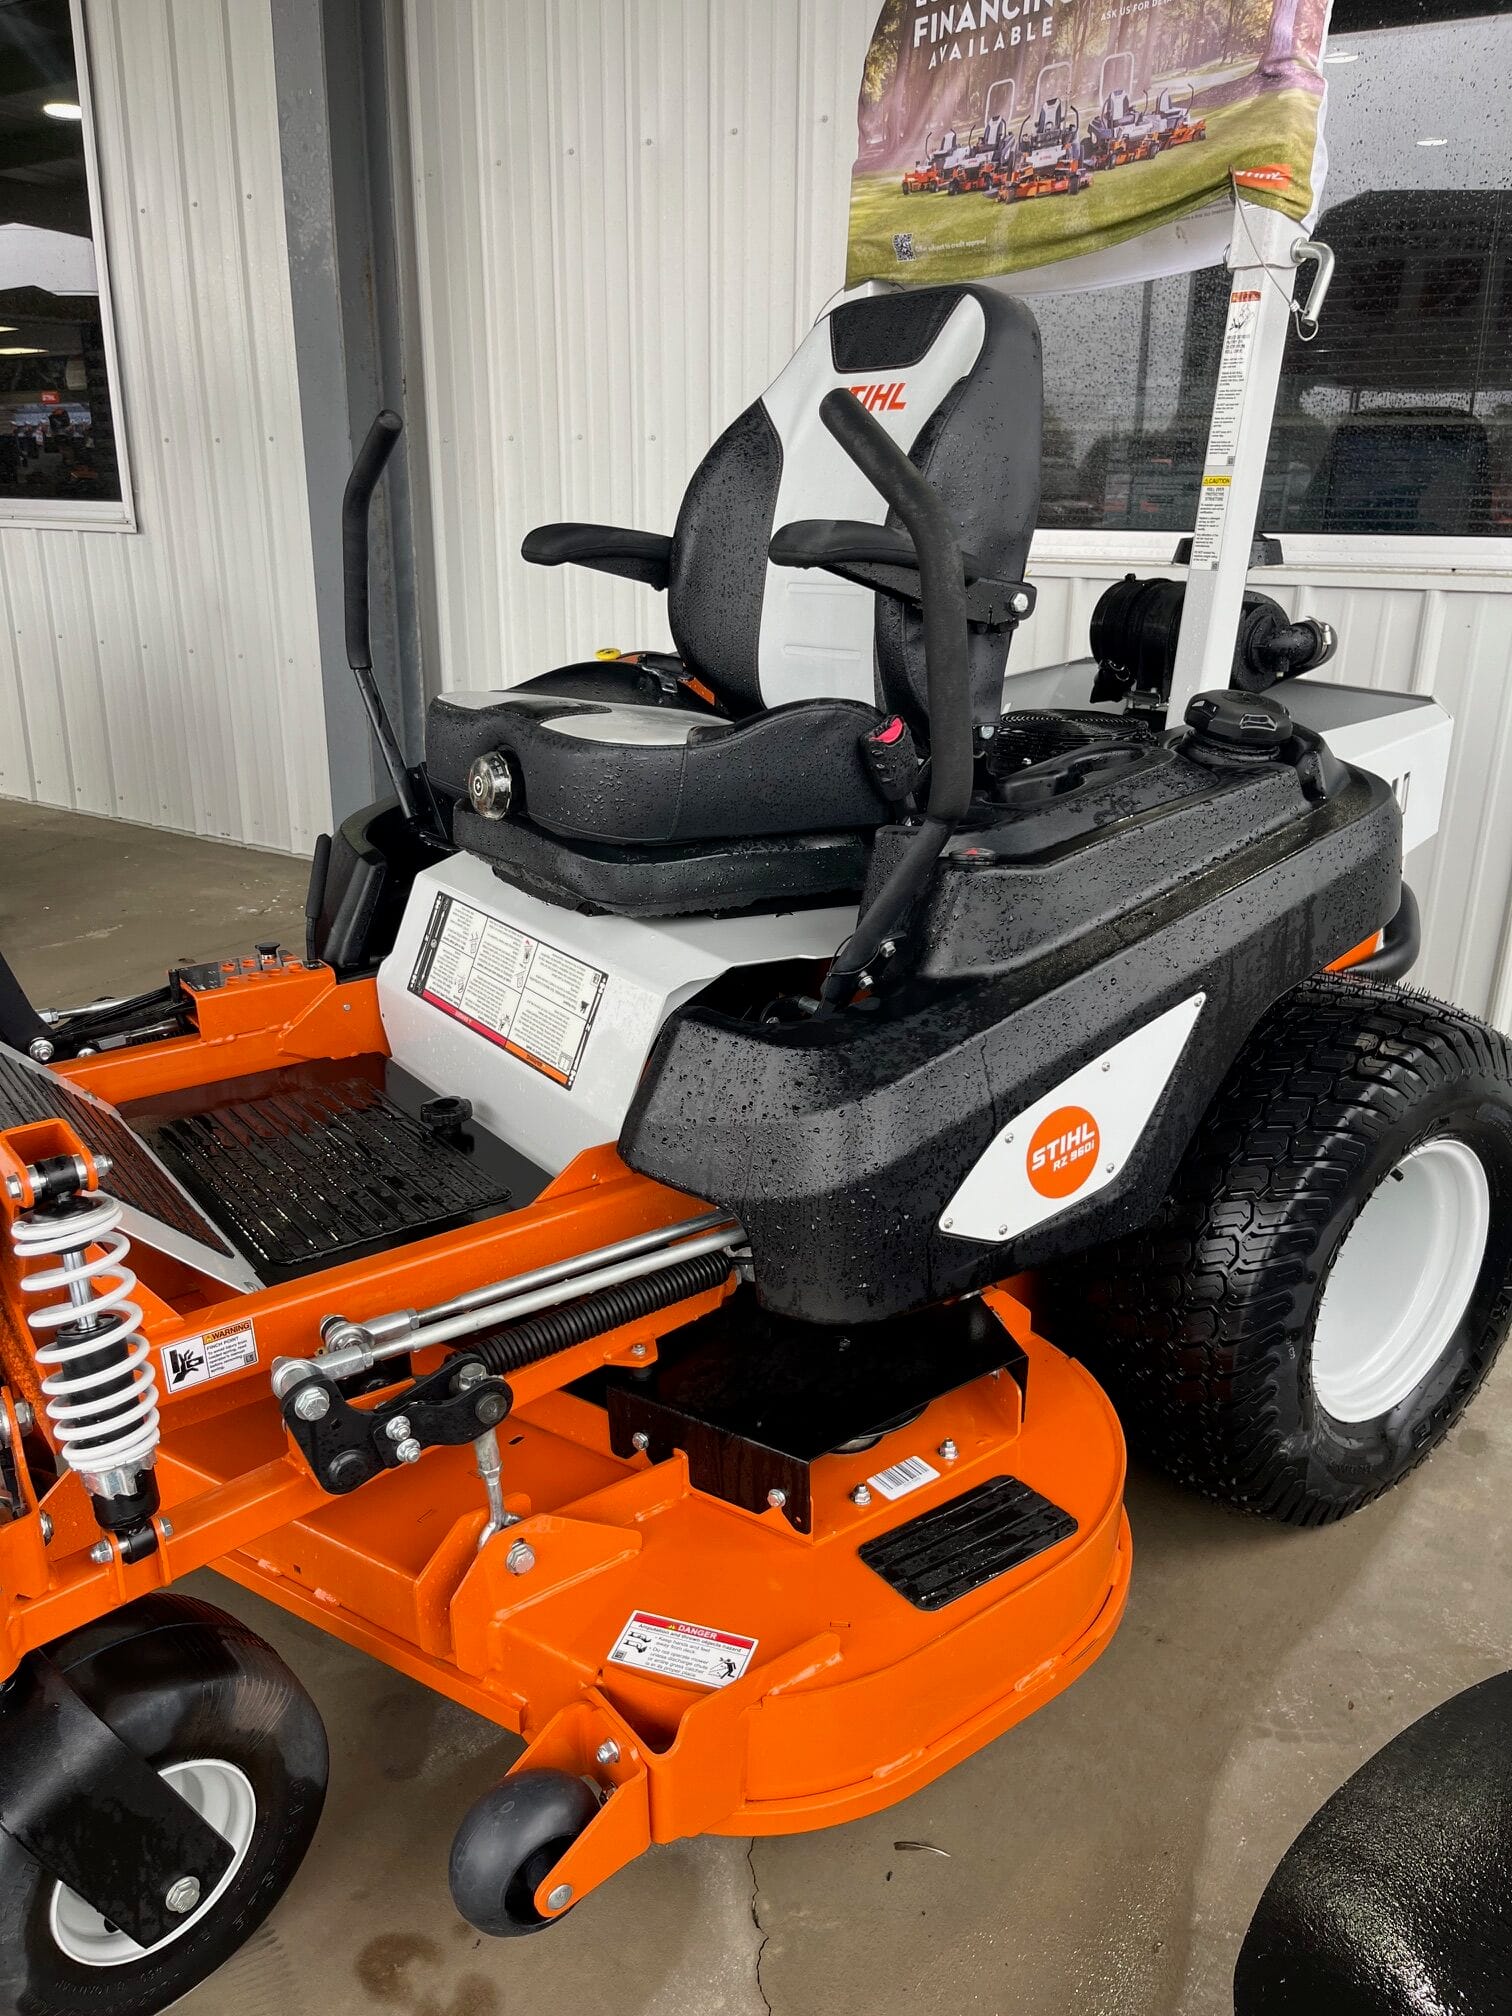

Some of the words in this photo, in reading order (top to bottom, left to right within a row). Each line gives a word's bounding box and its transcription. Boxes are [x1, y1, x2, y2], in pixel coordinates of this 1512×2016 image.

[1101, 9, 1118, 21] ASK
[1120, 6, 1131, 16] US
[1133, 2, 1150, 14] FOR
[928, 16, 1053, 70] AVAILABLE
[850, 382, 907, 411] TIHL
[1032, 1122, 1095, 1171] STIHL
[1053, 1154, 1068, 1172] RZ
[211, 1322, 250, 1340] WARNING
[206, 1340, 223, 1350] PINCH
[223, 1336, 239, 1345] POINT
[639, 1624, 670, 1634] Amputation
[678, 1625, 717, 1639] DANGER
